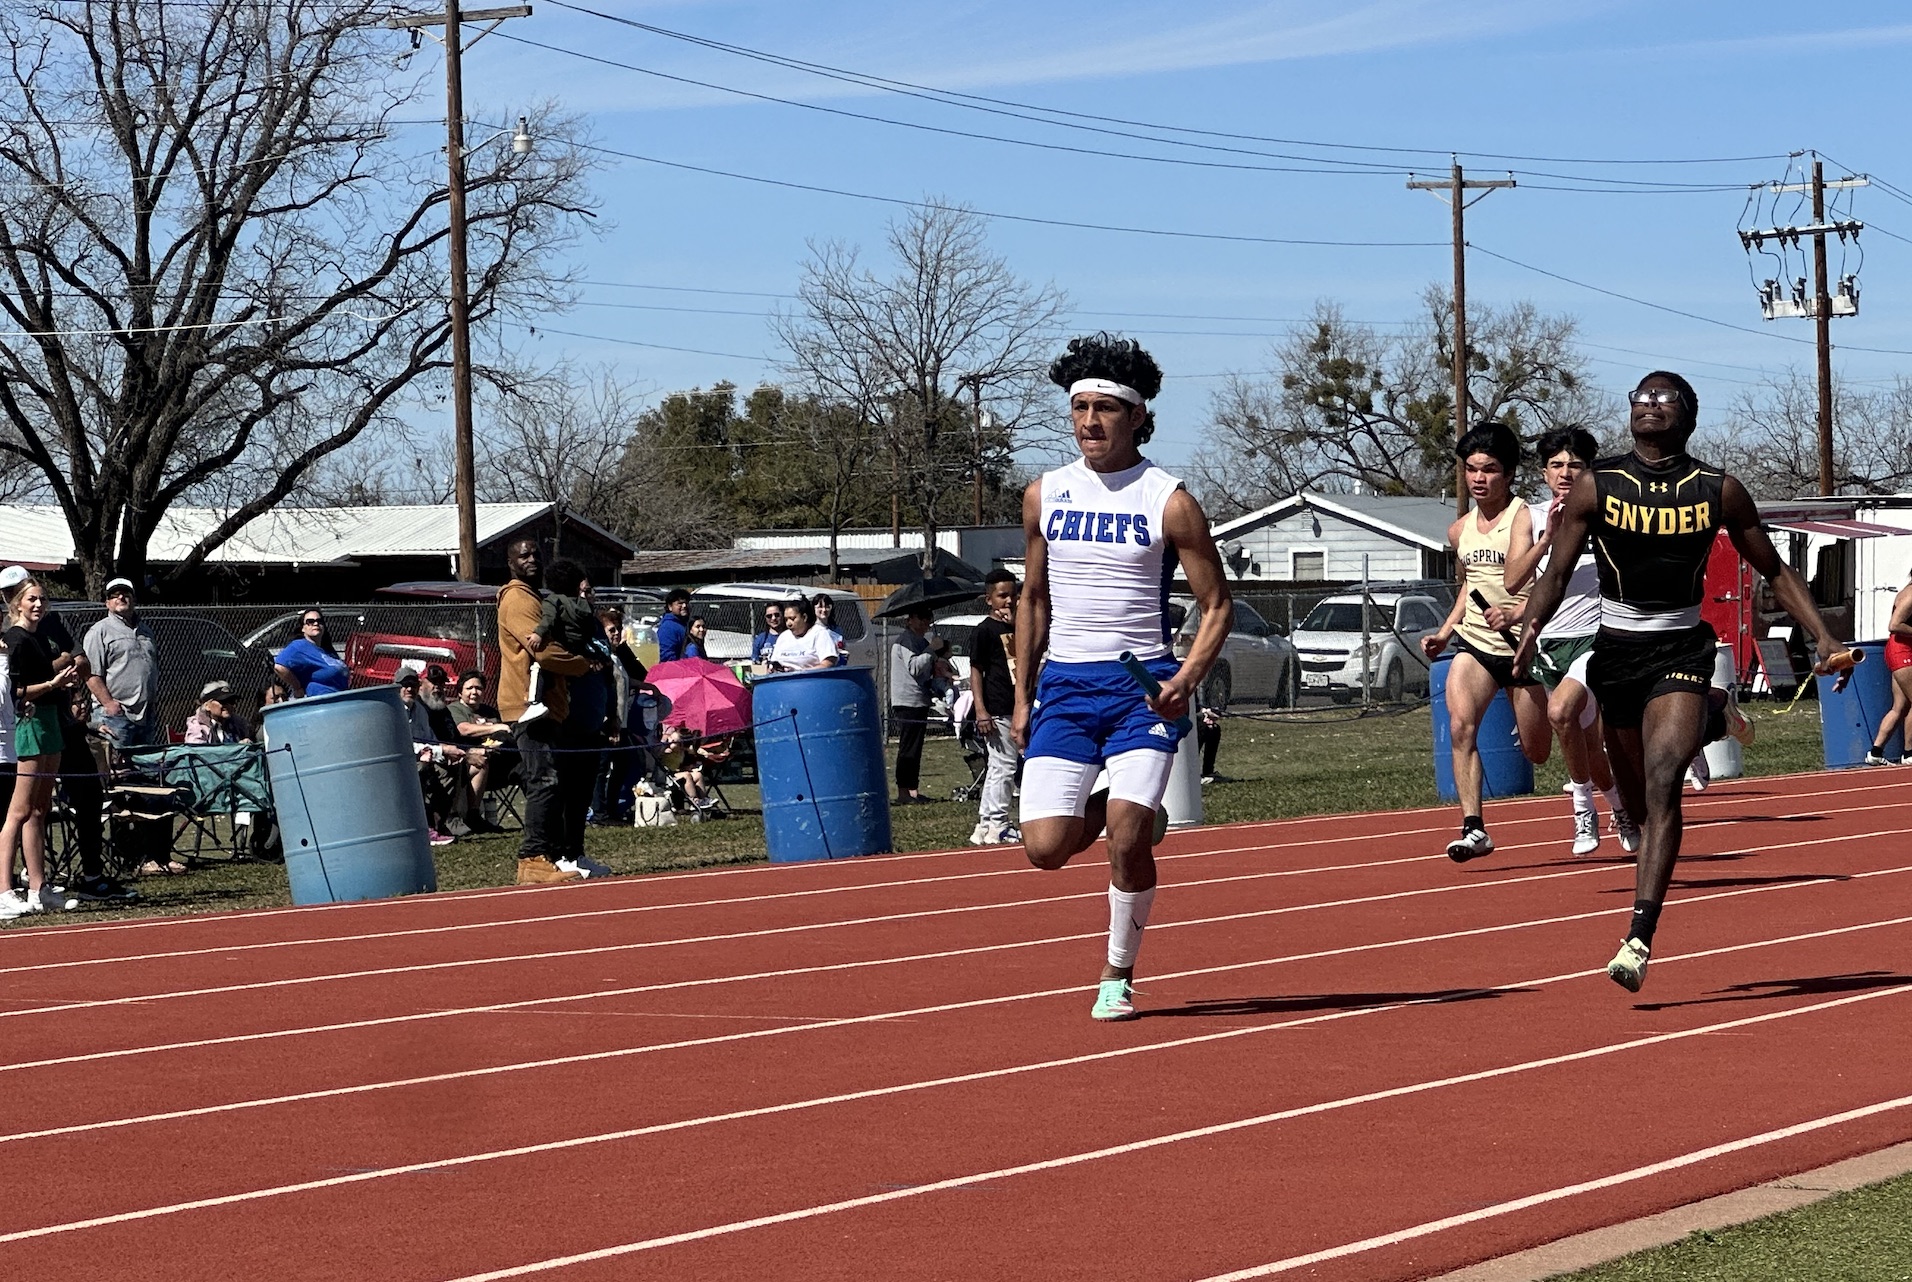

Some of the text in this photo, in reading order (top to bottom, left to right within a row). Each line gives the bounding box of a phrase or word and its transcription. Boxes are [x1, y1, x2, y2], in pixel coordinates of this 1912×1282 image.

[1046, 509, 1152, 547] CHIEFS
[1604, 494, 1711, 535] SNYDER
[1473, 549, 1505, 564] SPRIN
